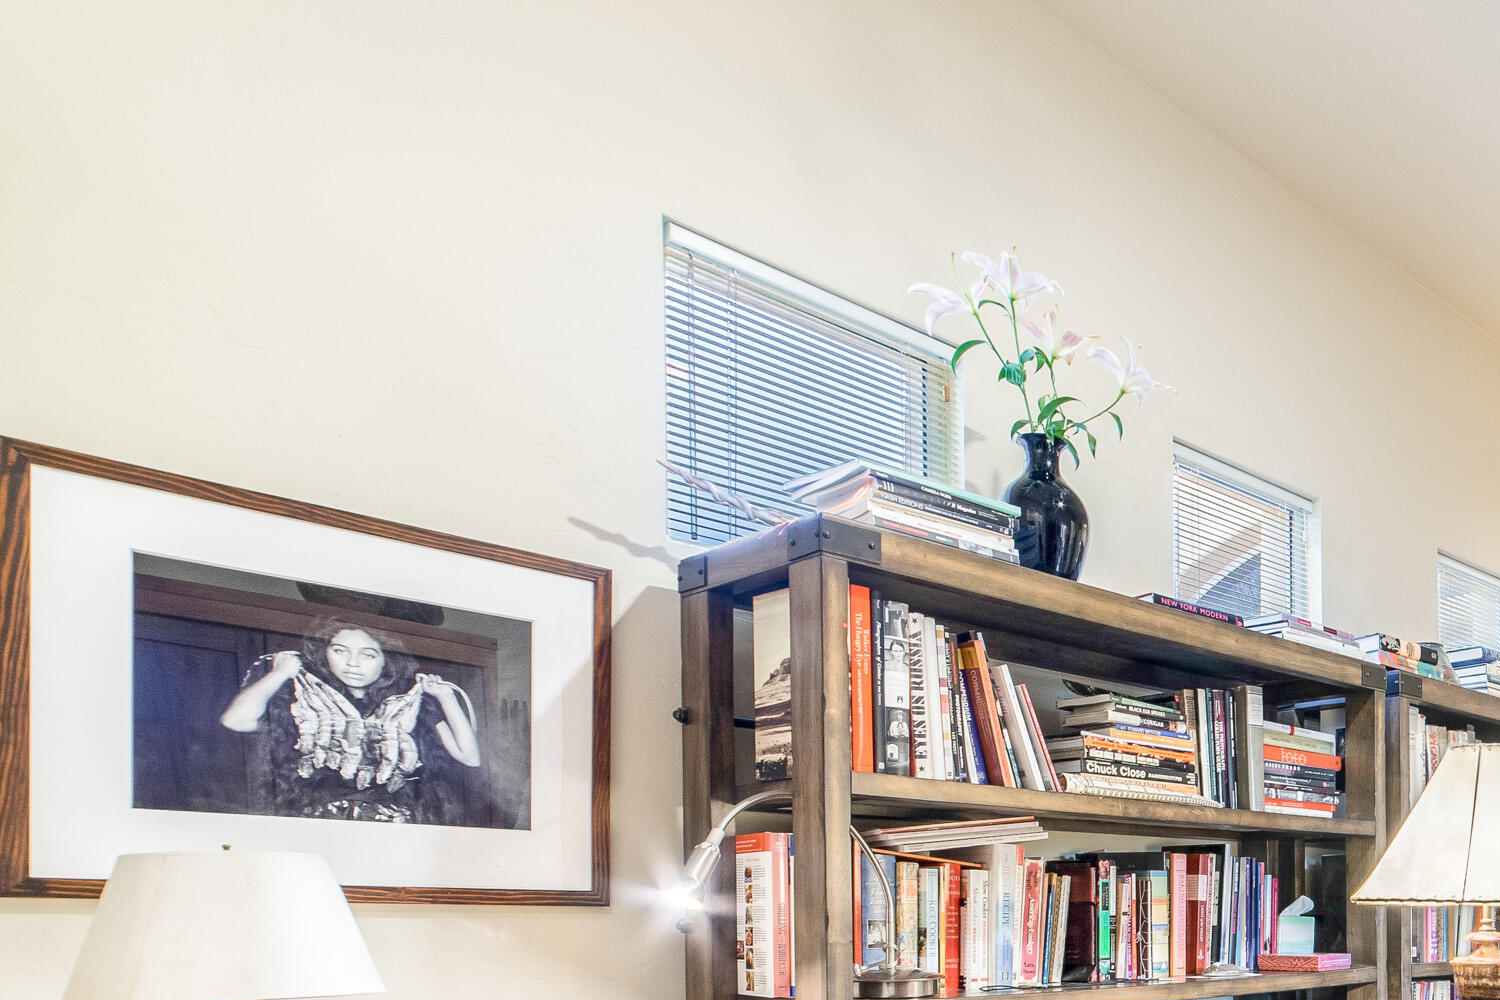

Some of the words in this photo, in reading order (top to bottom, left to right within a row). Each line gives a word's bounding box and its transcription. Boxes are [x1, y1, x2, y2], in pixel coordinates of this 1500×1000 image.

[1161, 598, 1177, 608] NEW
[1179, 602, 1198, 613] YORK
[1200, 608, 1228, 622] MODERN
[910, 630, 925, 692] RUSSIA
[913, 696, 926, 716] ON
[959, 671, 972, 721] COMPENDIUM
[1144, 719, 1164, 727] COUGAR
[914, 723, 927, 759] EYES
[1086, 762, 1117, 775] Chuck
[1120, 766, 1146, 778] Close
[1002, 893, 1010, 925] RECIPE
